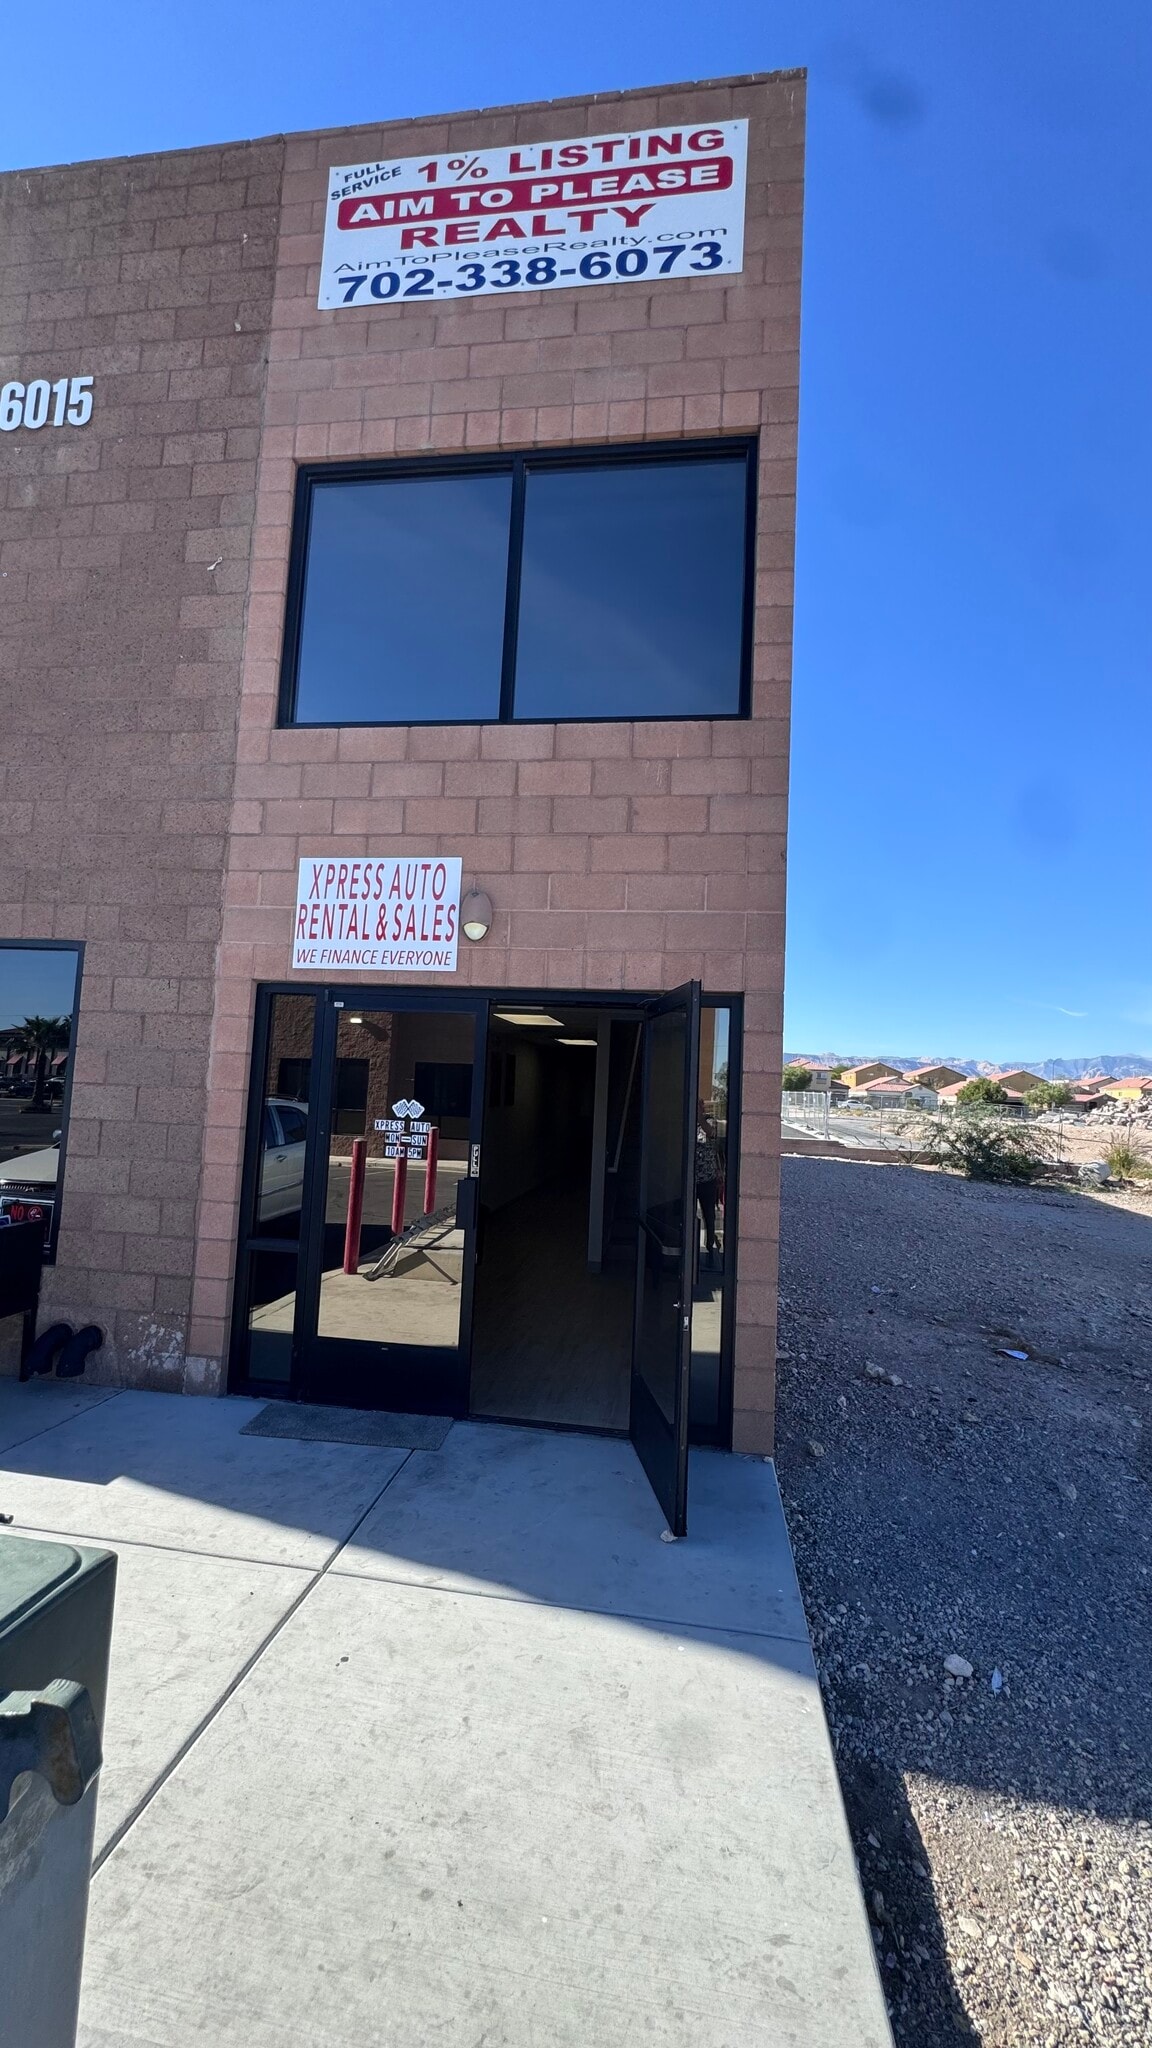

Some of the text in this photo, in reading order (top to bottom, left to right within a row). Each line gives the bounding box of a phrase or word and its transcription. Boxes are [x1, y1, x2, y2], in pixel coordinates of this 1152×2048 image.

[344, 164, 385, 183] FULL
[418, 129, 725, 183] 1% LISTING
[331, 166, 401, 200] SERVICE
[349, 164, 720, 223] AIM TO PLEASE
[333, 226, 728, 273] AimToPleaseRealty.com
[400, 203, 656, 250] REALTY
[337, 241, 723, 302] 702-338-6073
[0, 376, 94, 431] 6015
[309, 863, 447, 900] XPRESS AUTO
[297, 948, 452, 966] WE FINANCE EVERYONE
[375, 1120, 430, 1132] XPRESS AUTO
